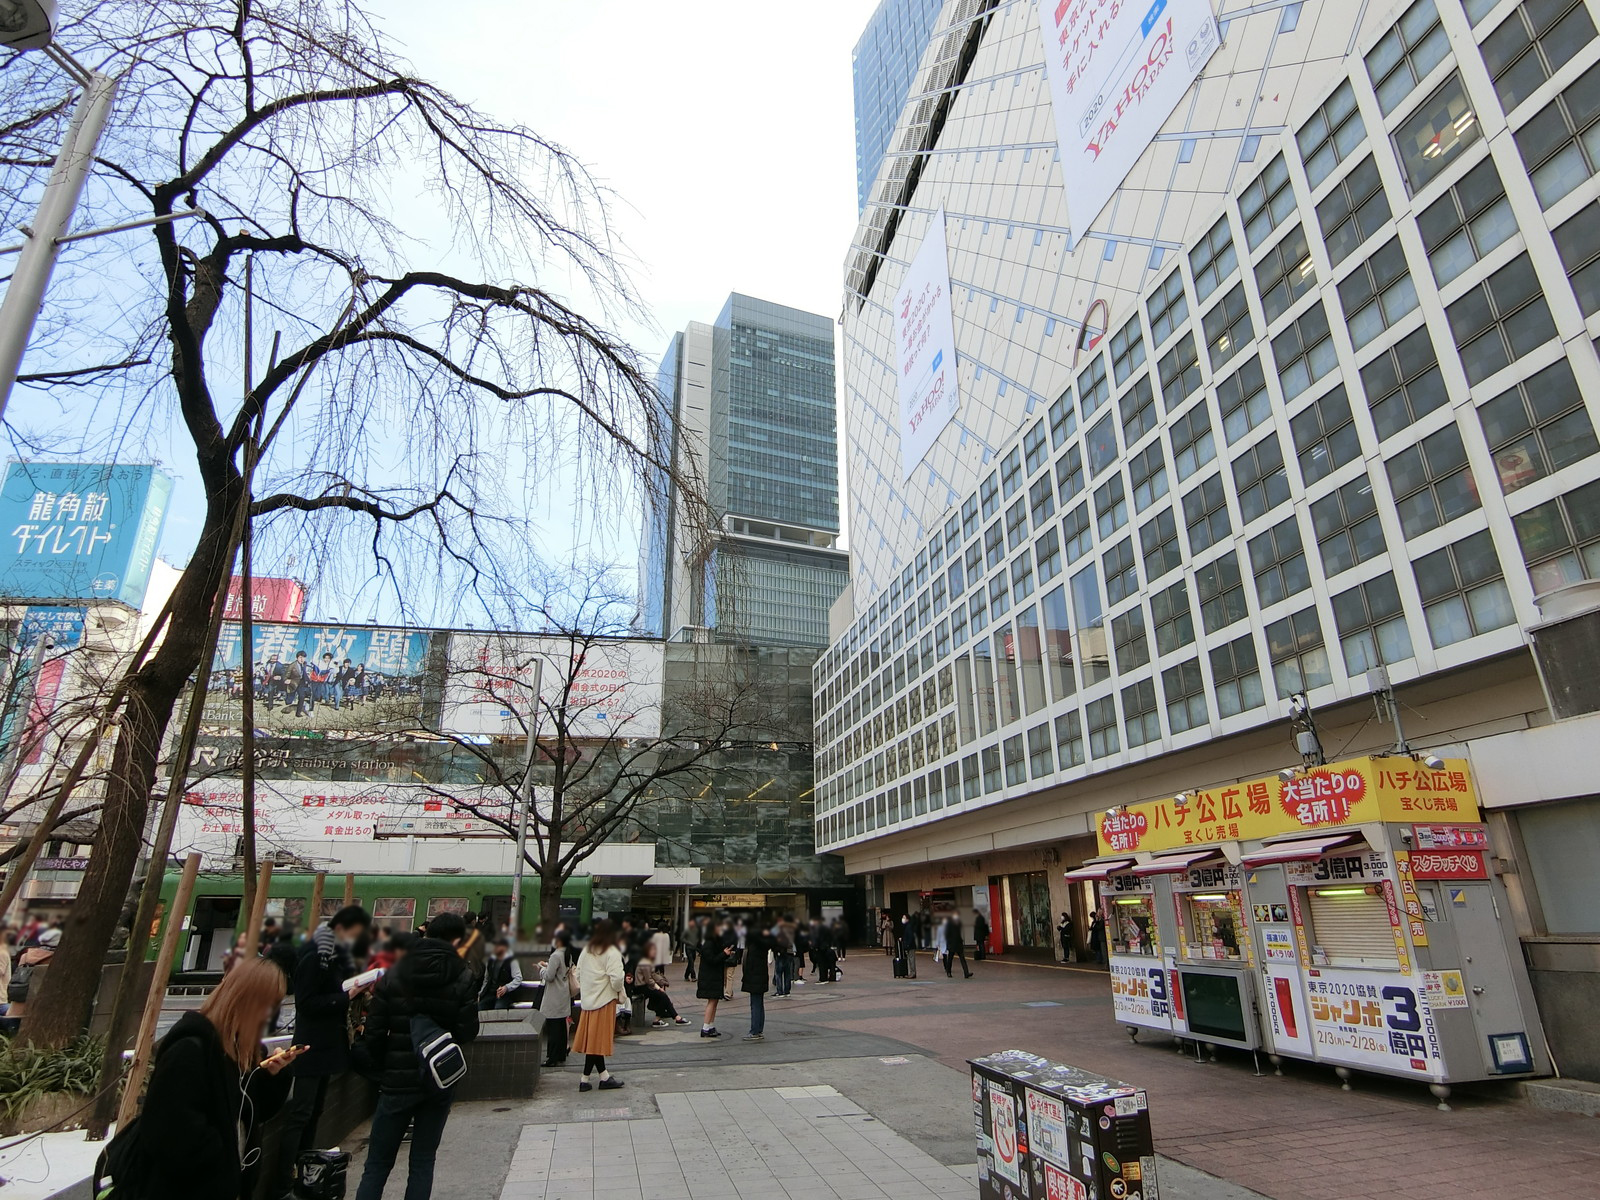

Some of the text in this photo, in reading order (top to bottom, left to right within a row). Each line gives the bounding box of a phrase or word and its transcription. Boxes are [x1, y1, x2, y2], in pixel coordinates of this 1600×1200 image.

[1066, 0, 1125, 94] 手に入れる
[1137, 46, 1173, 106] JAPAN
[1084, 16, 1172, 163] YAHOO!
[1083, 94, 1104, 129] 2020
[908, 370, 944, 435] YAHOO!
[28, 491, 110, 522] 龍角散
[11, 524, 113, 556] ダイレクト
[15, 559, 56, 569] スティック
[93, 579, 117, 591] 生薬
[570, 682, 626, 693] 開会式の日は
[183, 709, 235, 721] StBank
[292, 758, 347, 770] shibuya
[350, 758, 396, 771] station
[1283, 773, 1360, 803] 大当たりの
[1379, 770, 1468, 793] ハチ公広場
[208, 793, 268, 803] 東京20で
[329, 794, 388, 806] 東京2020で
[1154, 782, 1271, 830] ハチ公広場
[1400, 797, 1459, 812] 宝くじ売場
[205, 808, 271, 818] 来日した手に
[1297, 798, 1350, 825] 名所!!
[324, 825, 372, 836] 賞金出るの
[424, 821, 448, 830] 渋谷駅
[1103, 814, 1145, 834] 大当たりの
[1183, 823, 1240, 844] 宝くじ売場
[1110, 832, 1140, 850] 名所!!
[1313, 856, 1365, 881] 3億円
[1413, 855, 1479, 872] スクラッチくじ
[1115, 875, 1142, 892] 3億円
[1190, 869, 1226, 887] 3億円
[1373, 870, 1385, 878] 万円
[1397, 860, 1425, 937] 本日発売
[1266, 949, 1295, 959] 福バラ100
[1110, 965, 1148, 977] 東京2020協賛
[1111, 976, 1149, 998] ジャンボ
[1149, 968, 1167, 1001] 3
[1307, 981, 1378, 998] 東京2020協賛
[1151, 1000, 1170, 1019] 億円
[1310, 996, 1383, 1028] ジャンボ
[1382, 986, 1422, 1032] 3
[1387, 1031, 1428, 1059] 億円
